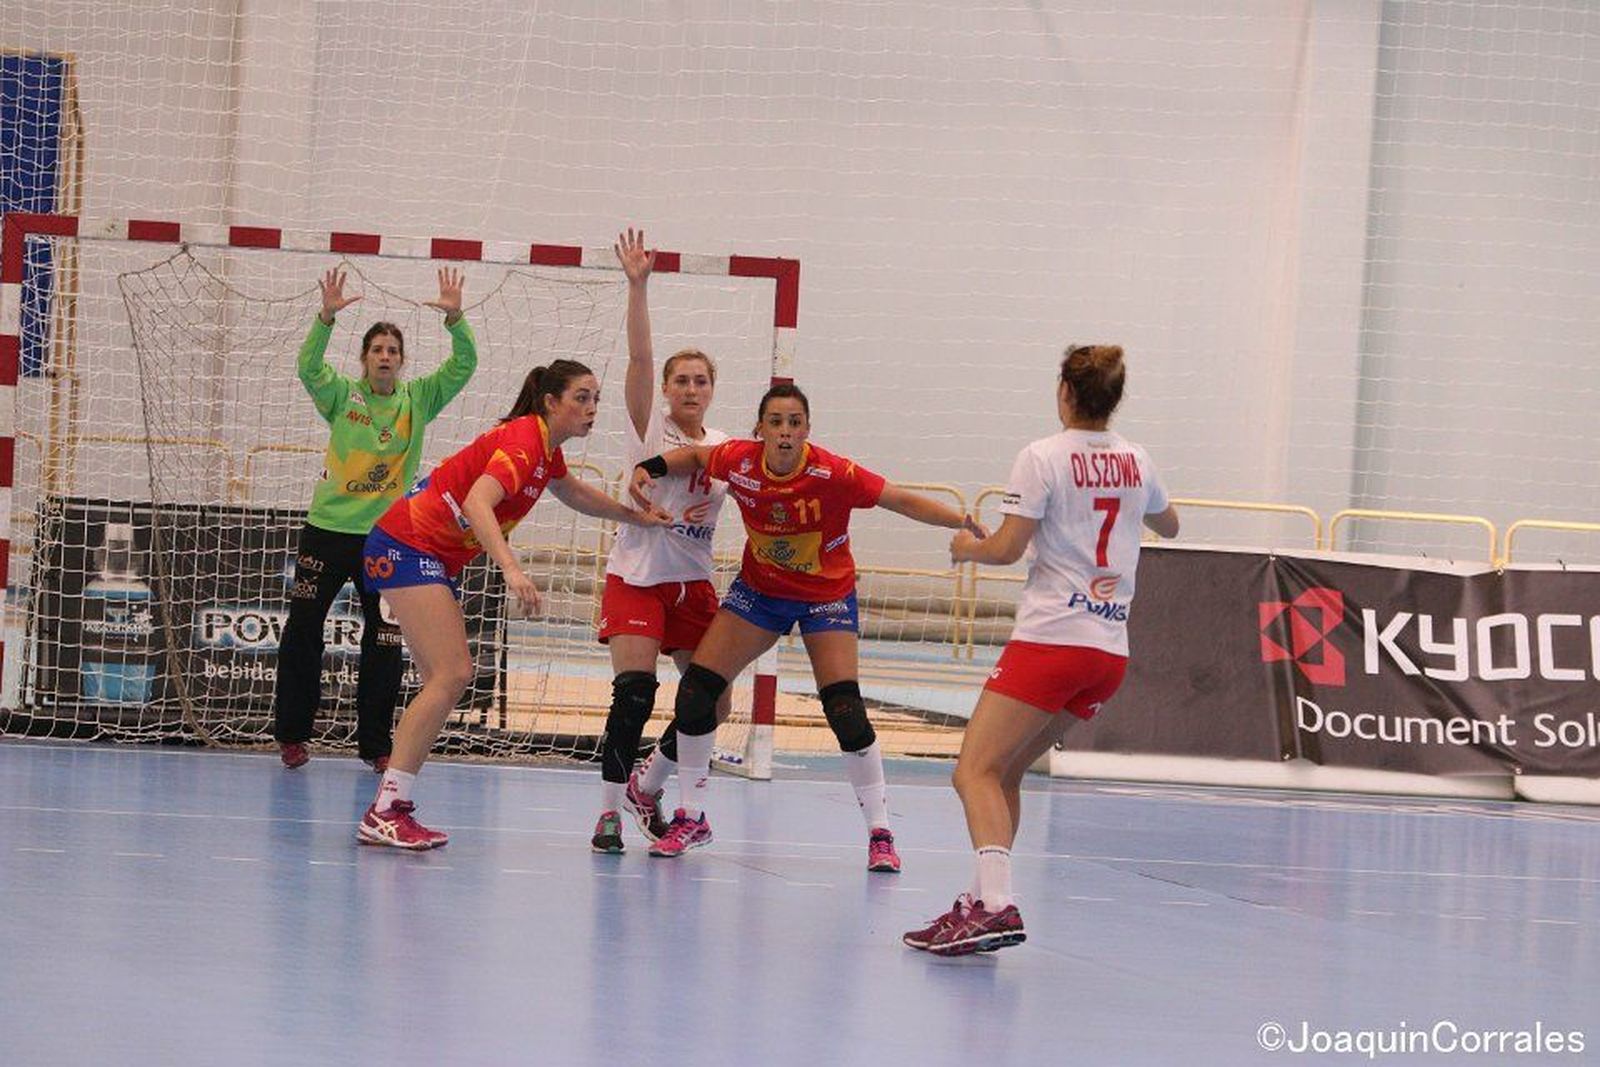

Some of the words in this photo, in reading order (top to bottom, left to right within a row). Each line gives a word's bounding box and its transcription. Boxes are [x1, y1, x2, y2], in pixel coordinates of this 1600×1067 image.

[346, 409, 373, 427] AVIS
[1071, 452, 1143, 488] OLSZOWA
[793, 498, 822, 525] 11
[1093, 497, 1121, 568] 7
[364, 556, 396, 580] GO
[205, 612, 363, 647] POR
[1361, 608, 1600, 681] KYOC
[204, 660, 276, 681] bebida
[1296, 696, 1517, 746] Document
